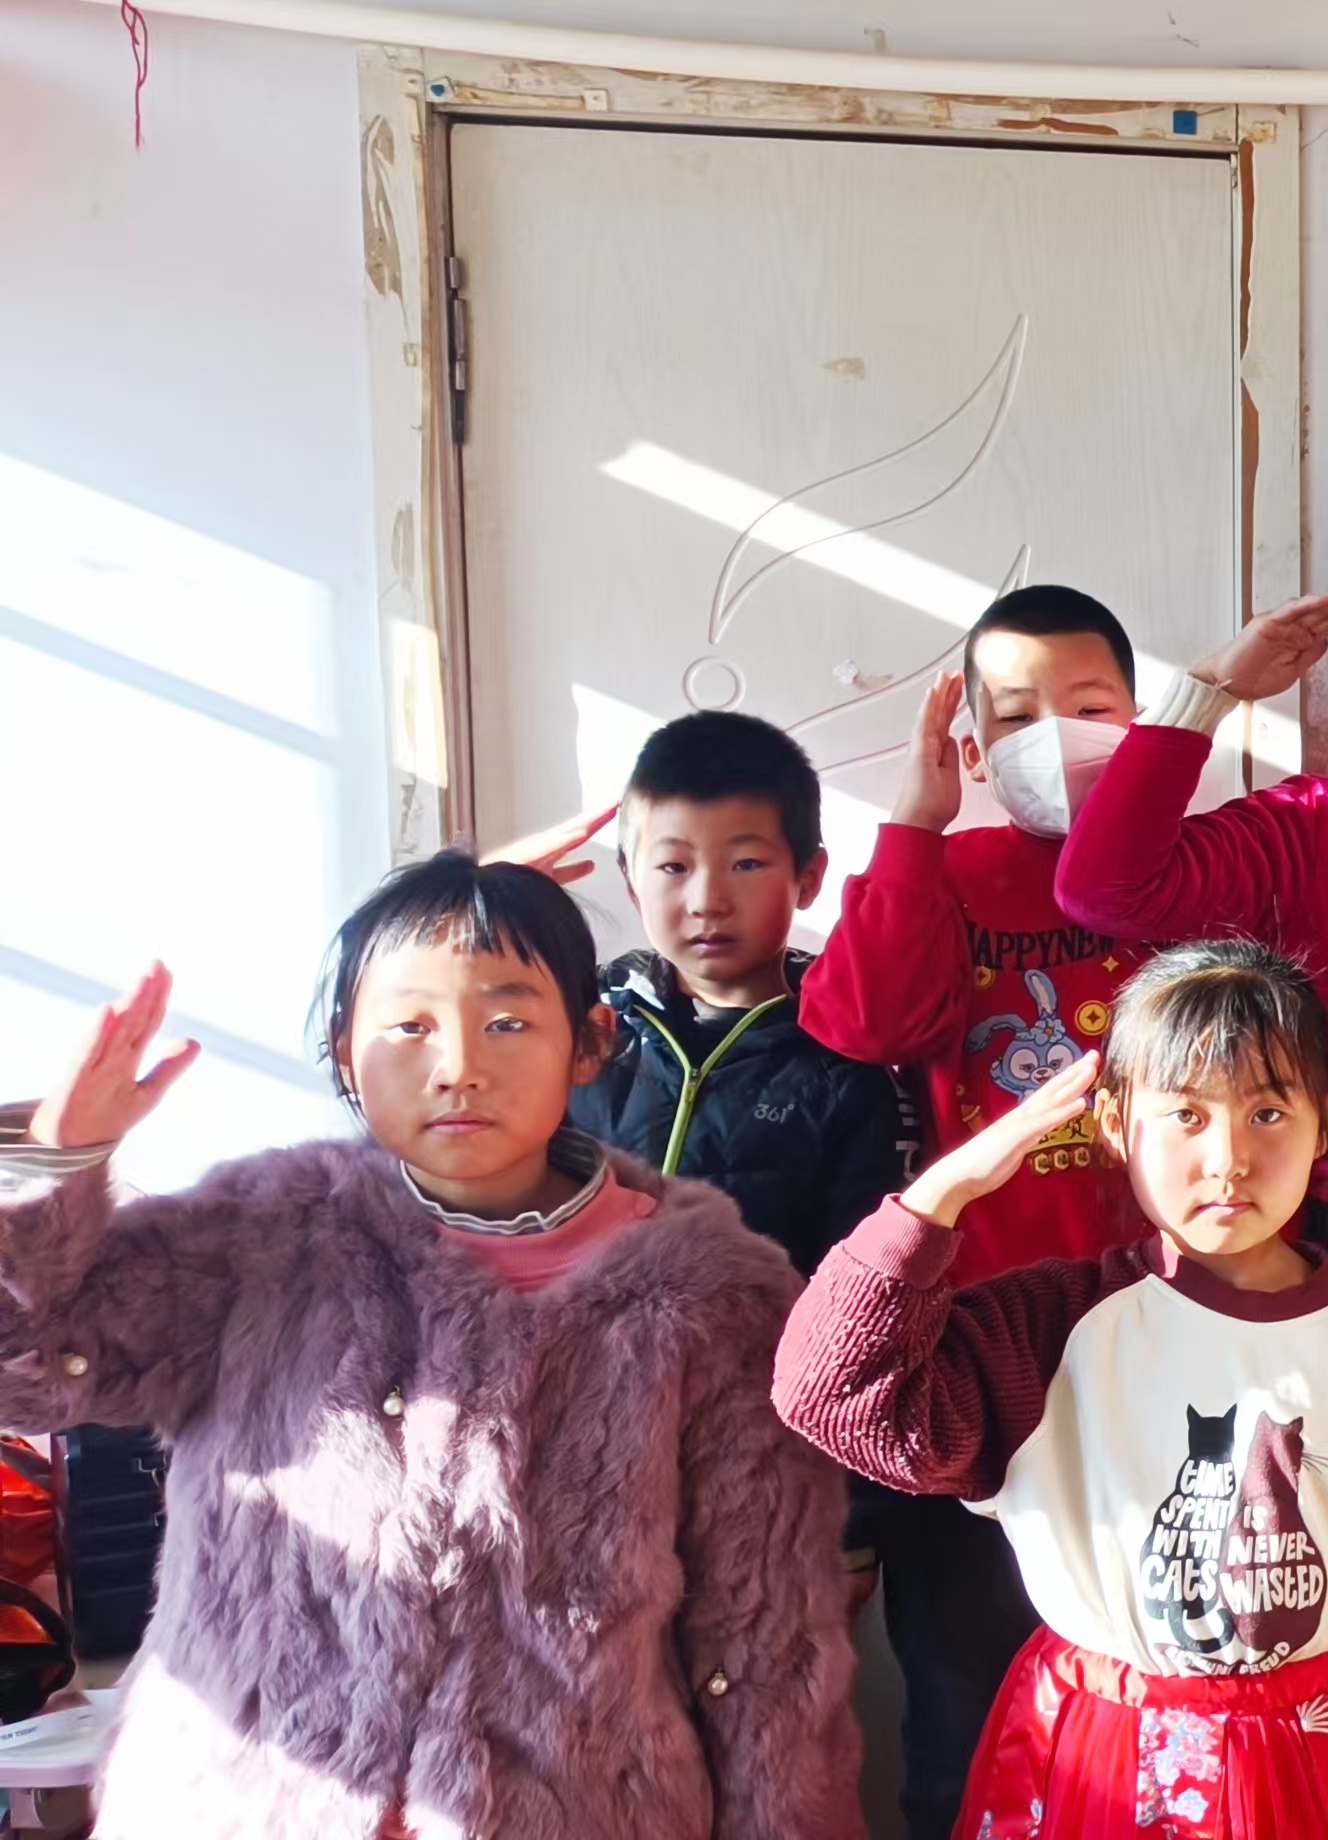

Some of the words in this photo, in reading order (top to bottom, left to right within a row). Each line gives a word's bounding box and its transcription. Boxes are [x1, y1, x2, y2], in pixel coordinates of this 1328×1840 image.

[1160, 1494, 1232, 1530] SPENT
[1151, 1523, 1223, 1560] WITH
[1227, 1531, 1316, 1567] NEVER
